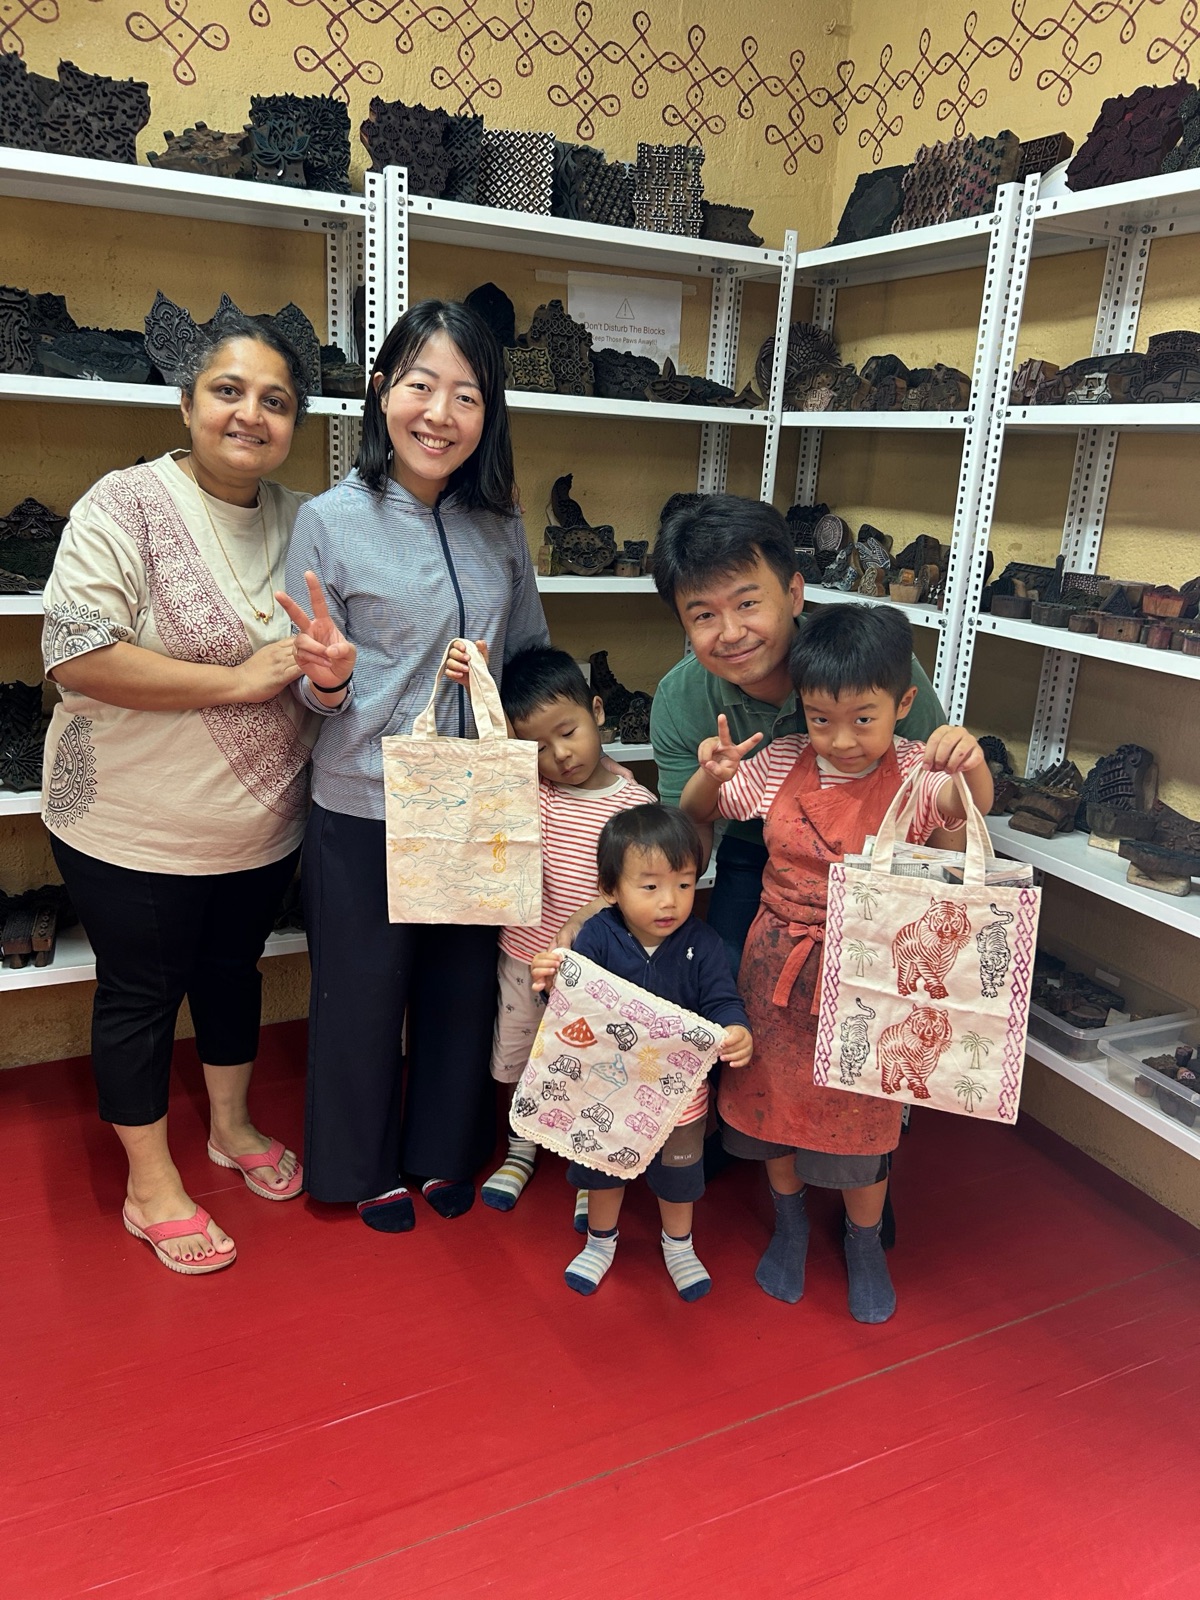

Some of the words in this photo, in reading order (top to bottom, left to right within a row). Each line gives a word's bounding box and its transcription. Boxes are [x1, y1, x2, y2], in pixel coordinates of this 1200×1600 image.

[584, 322, 602, 330] Don't
[604, 323, 627, 333] Disturb
[630, 325, 642, 333] The
[644, 327, 666, 336] Blocks
